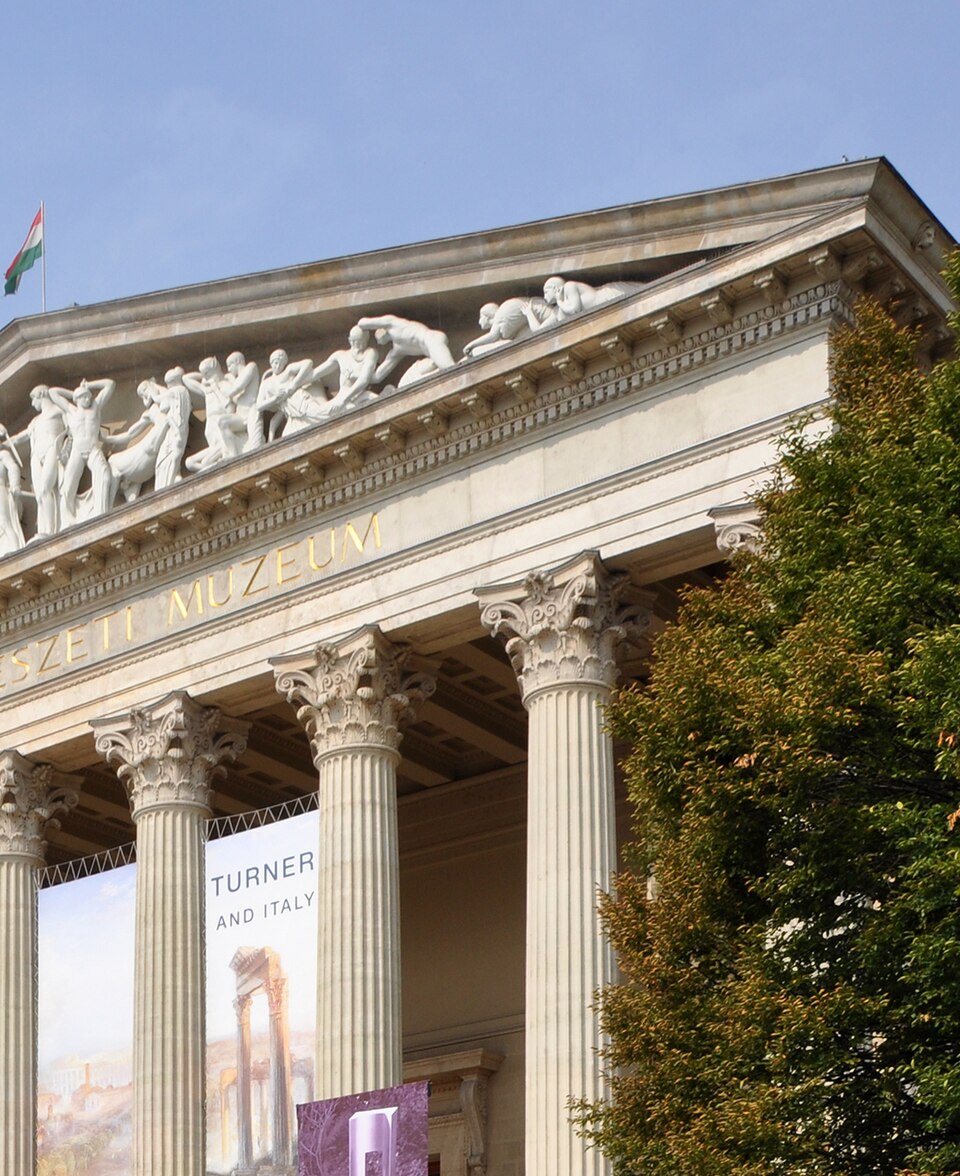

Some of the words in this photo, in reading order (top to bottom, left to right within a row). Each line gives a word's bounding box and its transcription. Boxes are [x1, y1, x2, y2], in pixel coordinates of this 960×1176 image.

[167, 511, 382, 626] MUZEUM
[211, 851, 314, 896] TURNER
[216, 908, 254, 931] AND
[264, 891, 315, 918] ITALY
